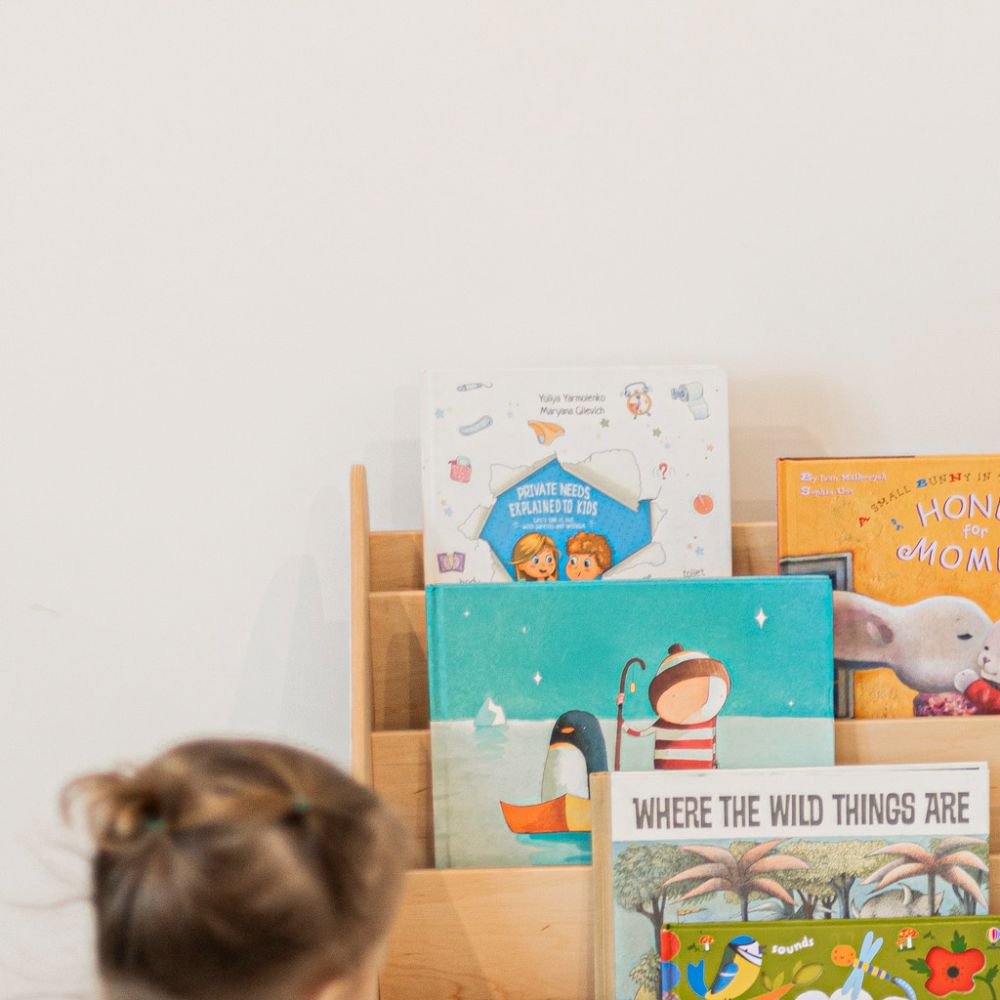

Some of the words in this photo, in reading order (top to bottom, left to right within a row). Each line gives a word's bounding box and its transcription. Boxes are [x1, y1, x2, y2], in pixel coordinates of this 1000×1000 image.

[517, 482, 557, 500] PRIVATE
[561, 483, 591, 500] NEEDS
[858, 517, 871, 528] A
[870, 485, 911, 513] SMALL
[916, 472, 972, 489] BUNNY
[977, 471, 992, 482] IN
[509, 499, 560, 517] EXPLAINED
[563, 499, 573, 514] TO
[577, 500, 598, 516] KIDS
[963, 523, 989, 539] for
[632, 796, 712, 830] WHERE
[719, 795, 760, 828] THE
[769, 794, 824, 827] WILD
[832, 792, 915, 826] THINGS
[925, 791, 970, 824] ARE
[771, 936, 815, 955] sounds
